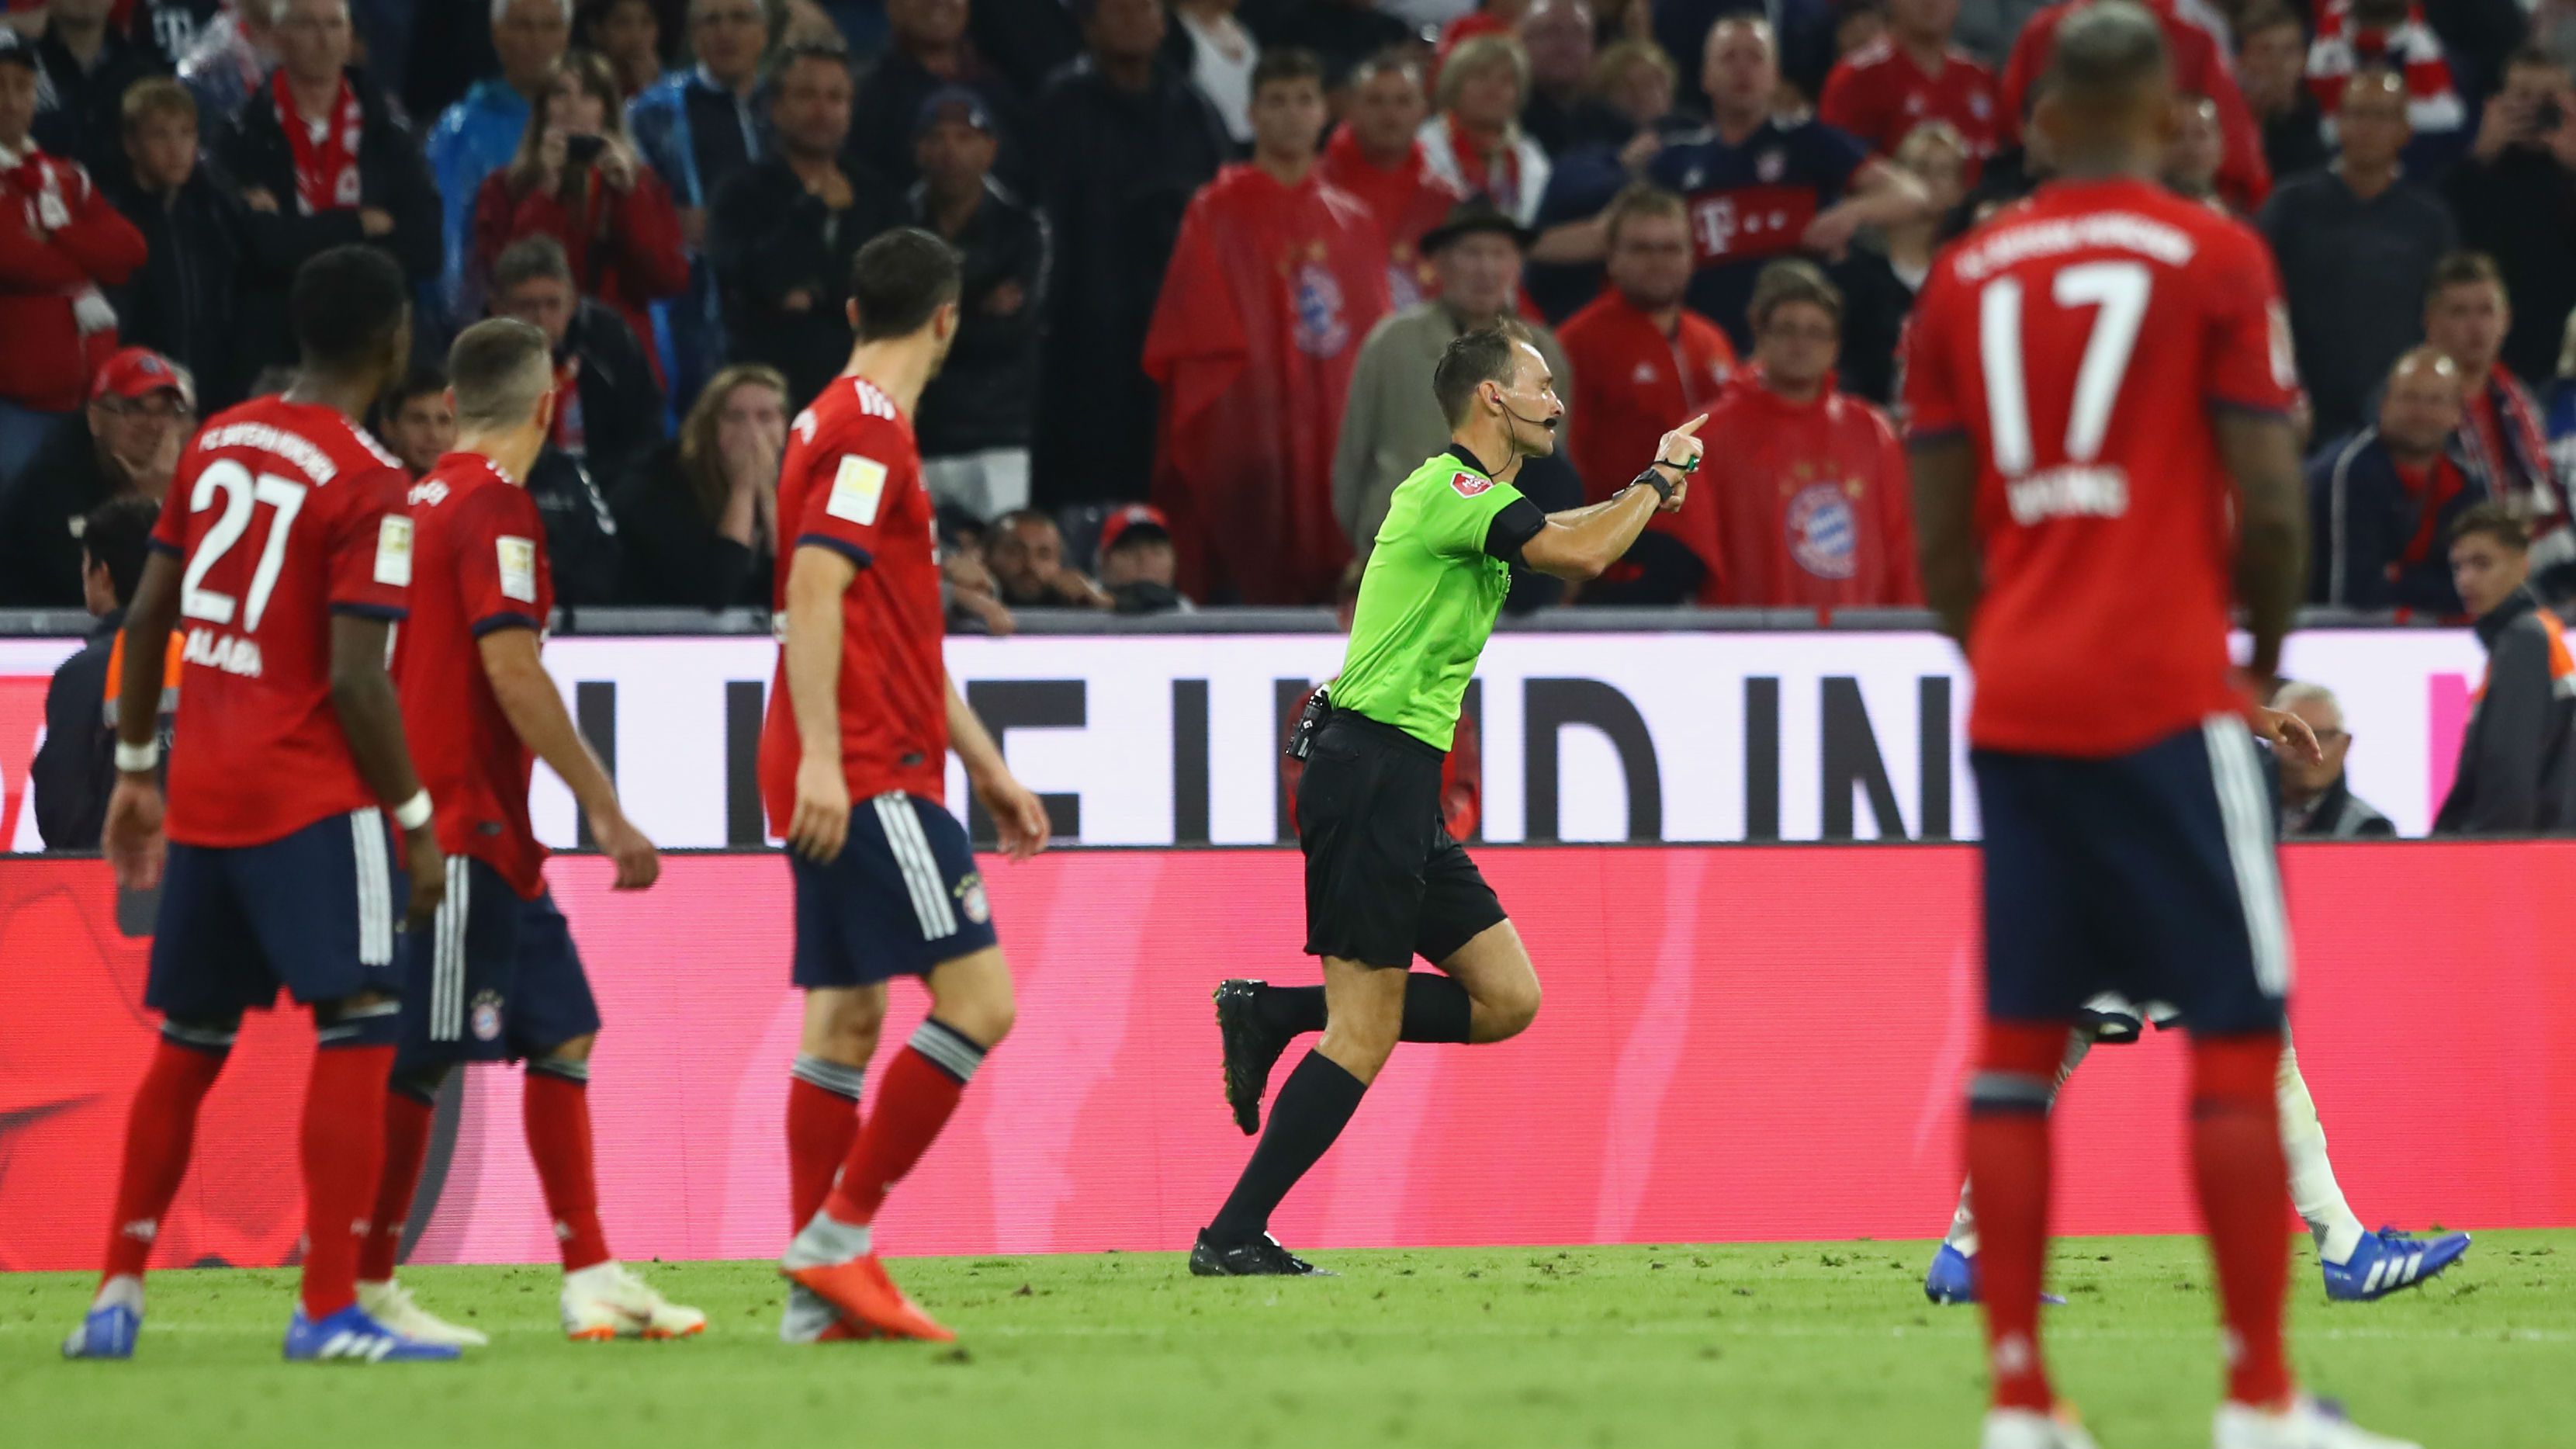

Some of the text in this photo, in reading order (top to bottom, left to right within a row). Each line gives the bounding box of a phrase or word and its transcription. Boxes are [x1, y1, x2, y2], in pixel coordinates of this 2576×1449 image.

[1979, 259, 2155, 479] 17
[181, 457, 307, 634] 27
[182, 626, 264, 679] ALABA
